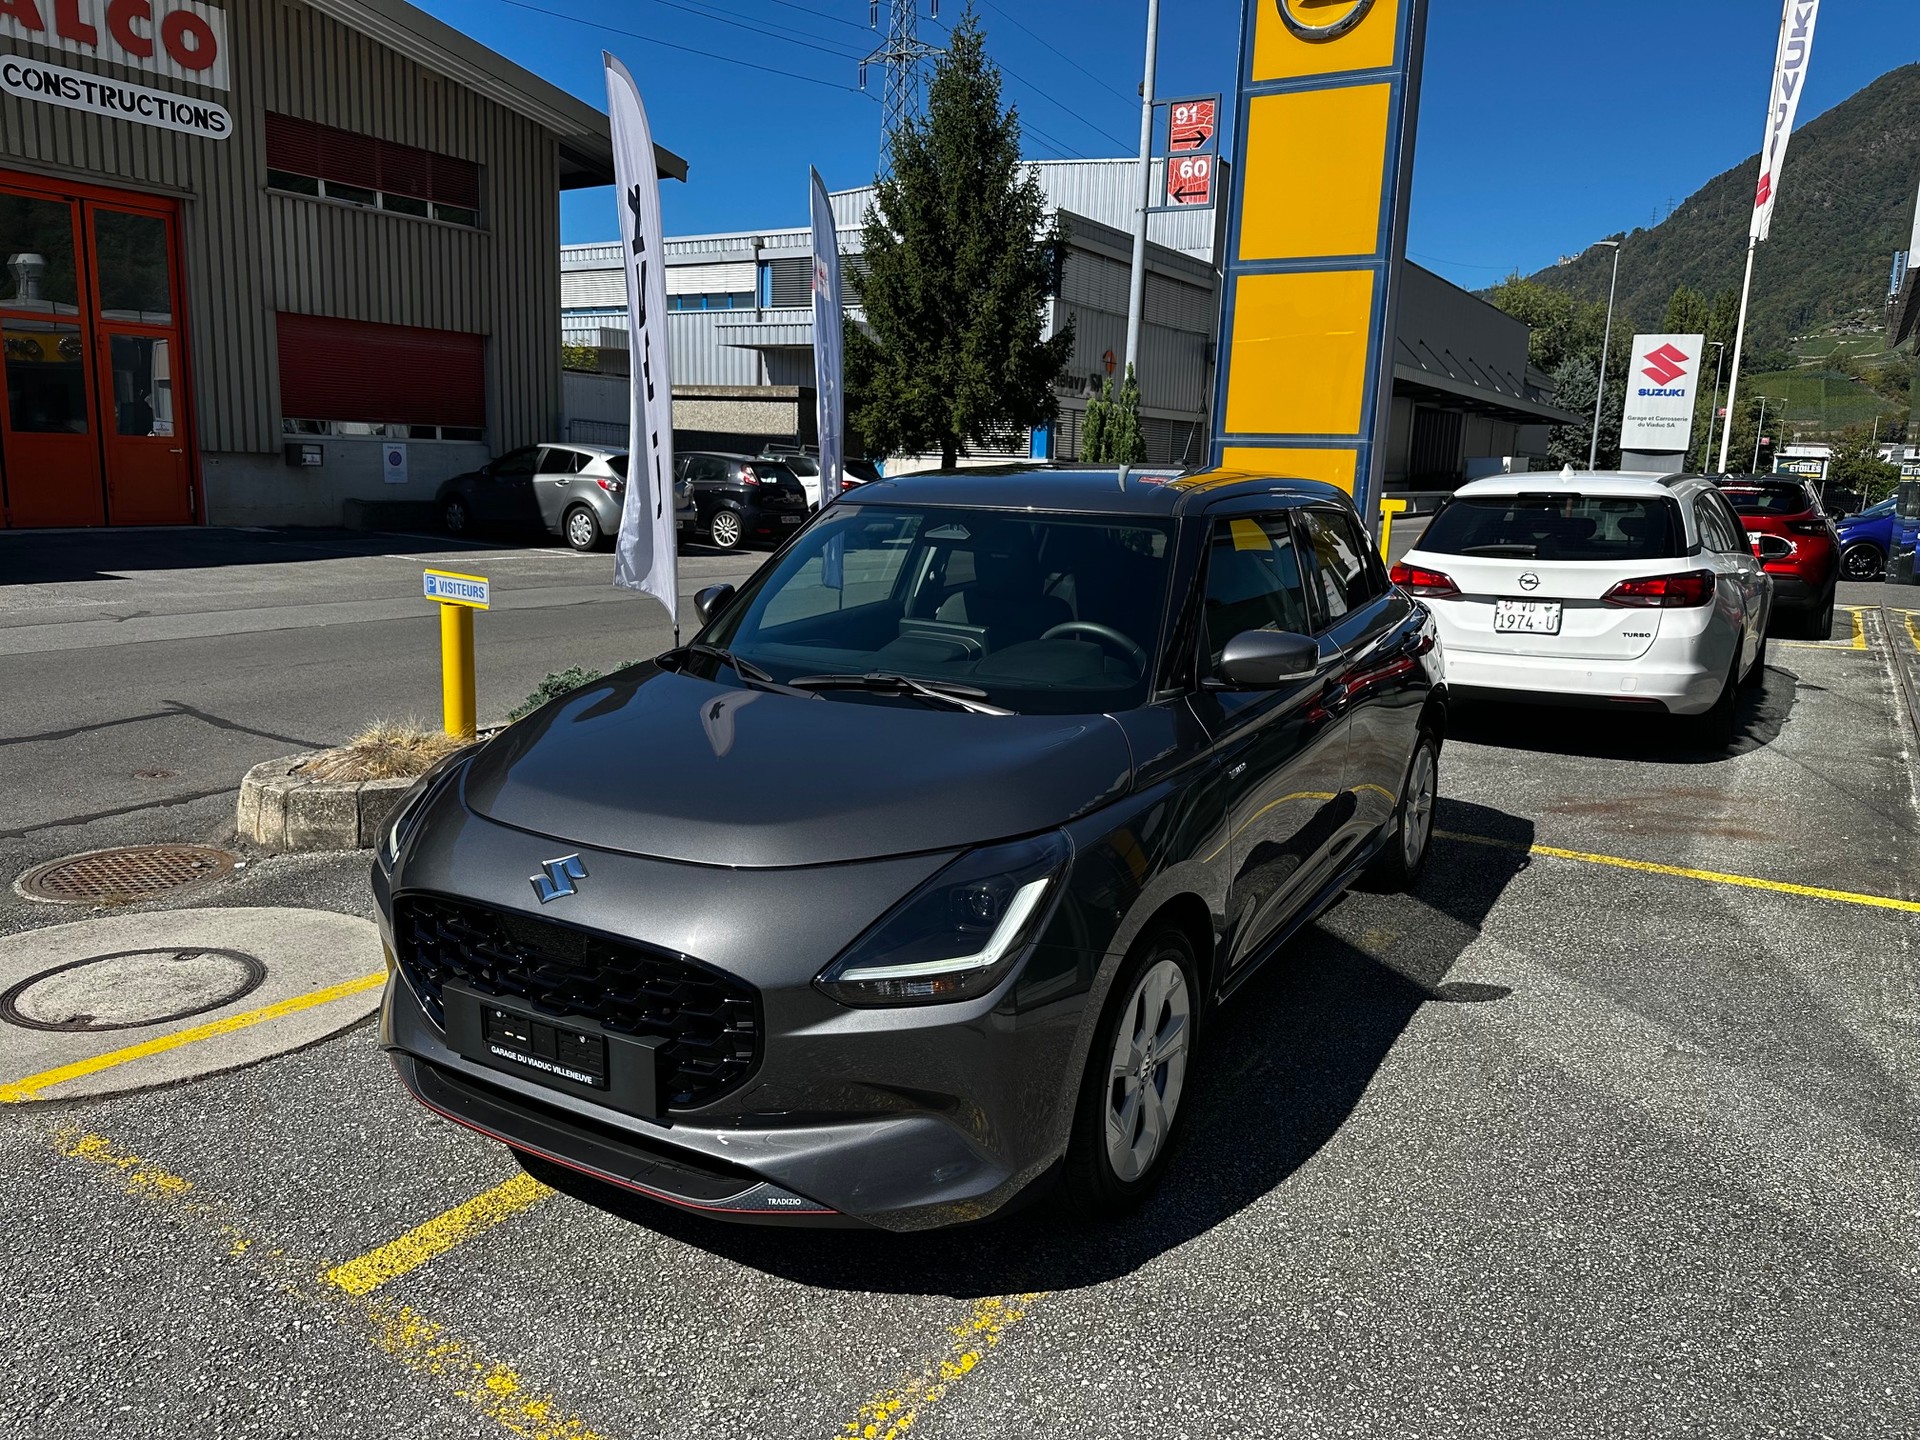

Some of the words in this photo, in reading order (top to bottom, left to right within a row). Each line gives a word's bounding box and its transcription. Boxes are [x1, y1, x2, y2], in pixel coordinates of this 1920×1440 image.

[2, 63, 226, 132] CONSTRUCTIONS
[1175, 105, 1198, 124] 91
[1179, 159, 1208, 178] 60
[1638, 388, 1685, 397] SUZUKI
[1789, 464, 1822, 473] ETOILES
[439, 580, 485, 599] VISITEURS
[491, 1045, 517, 1060] GARAGE
[517, 1053, 527, 1064] DU
[527, 1057, 552, 1072] VIADUC
[552, 1065, 593, 1085] VILLENEUVE
[767, 1198, 802, 1206] TRADIZIO
